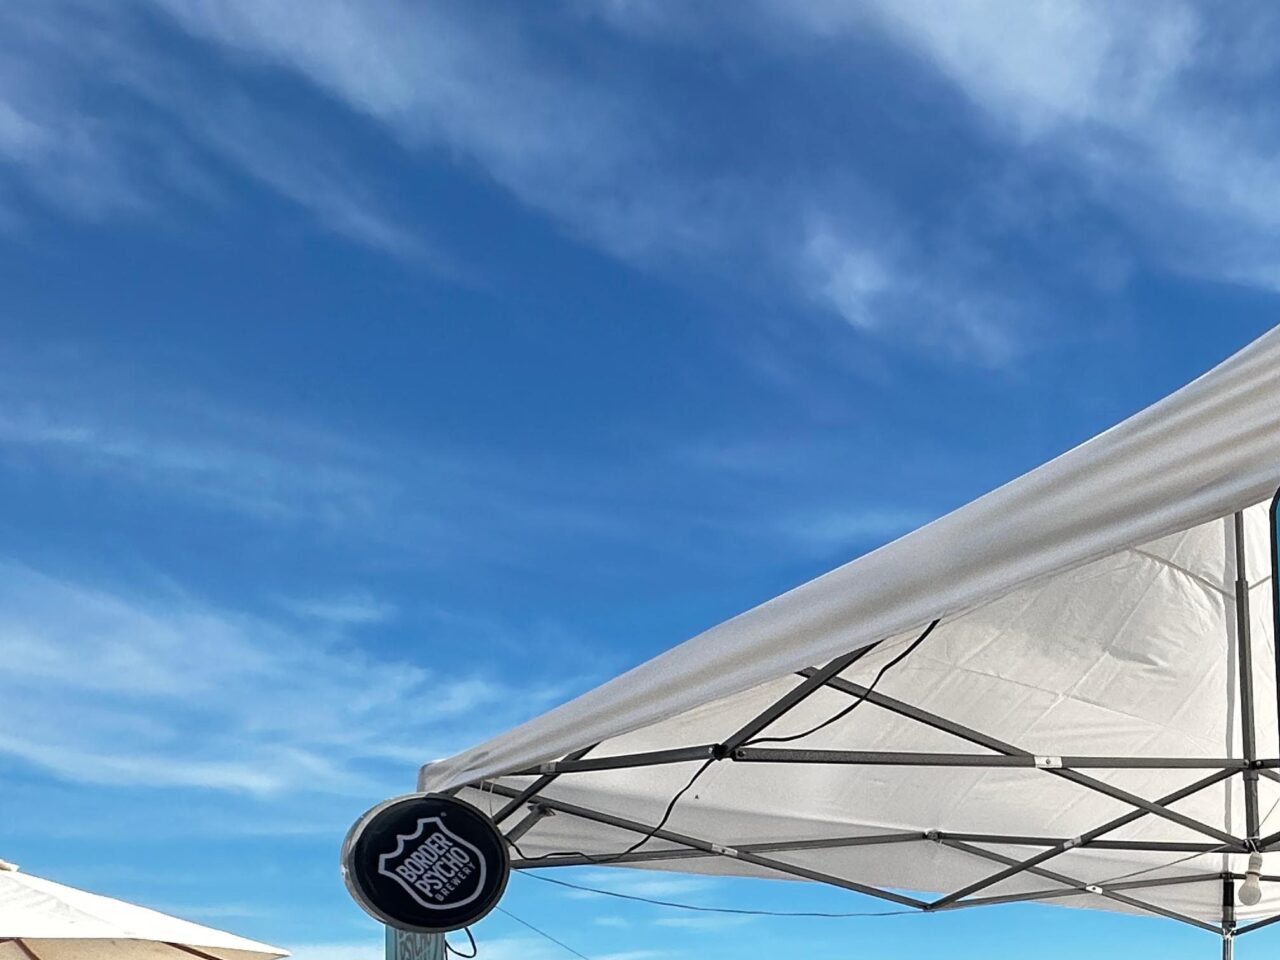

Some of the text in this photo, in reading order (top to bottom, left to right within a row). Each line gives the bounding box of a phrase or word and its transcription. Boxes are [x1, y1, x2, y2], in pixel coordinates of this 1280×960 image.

[396, 831, 454, 884] BORDER
[415, 846, 470, 898] PSYCHO
[434, 861, 477, 902] BREWERY
